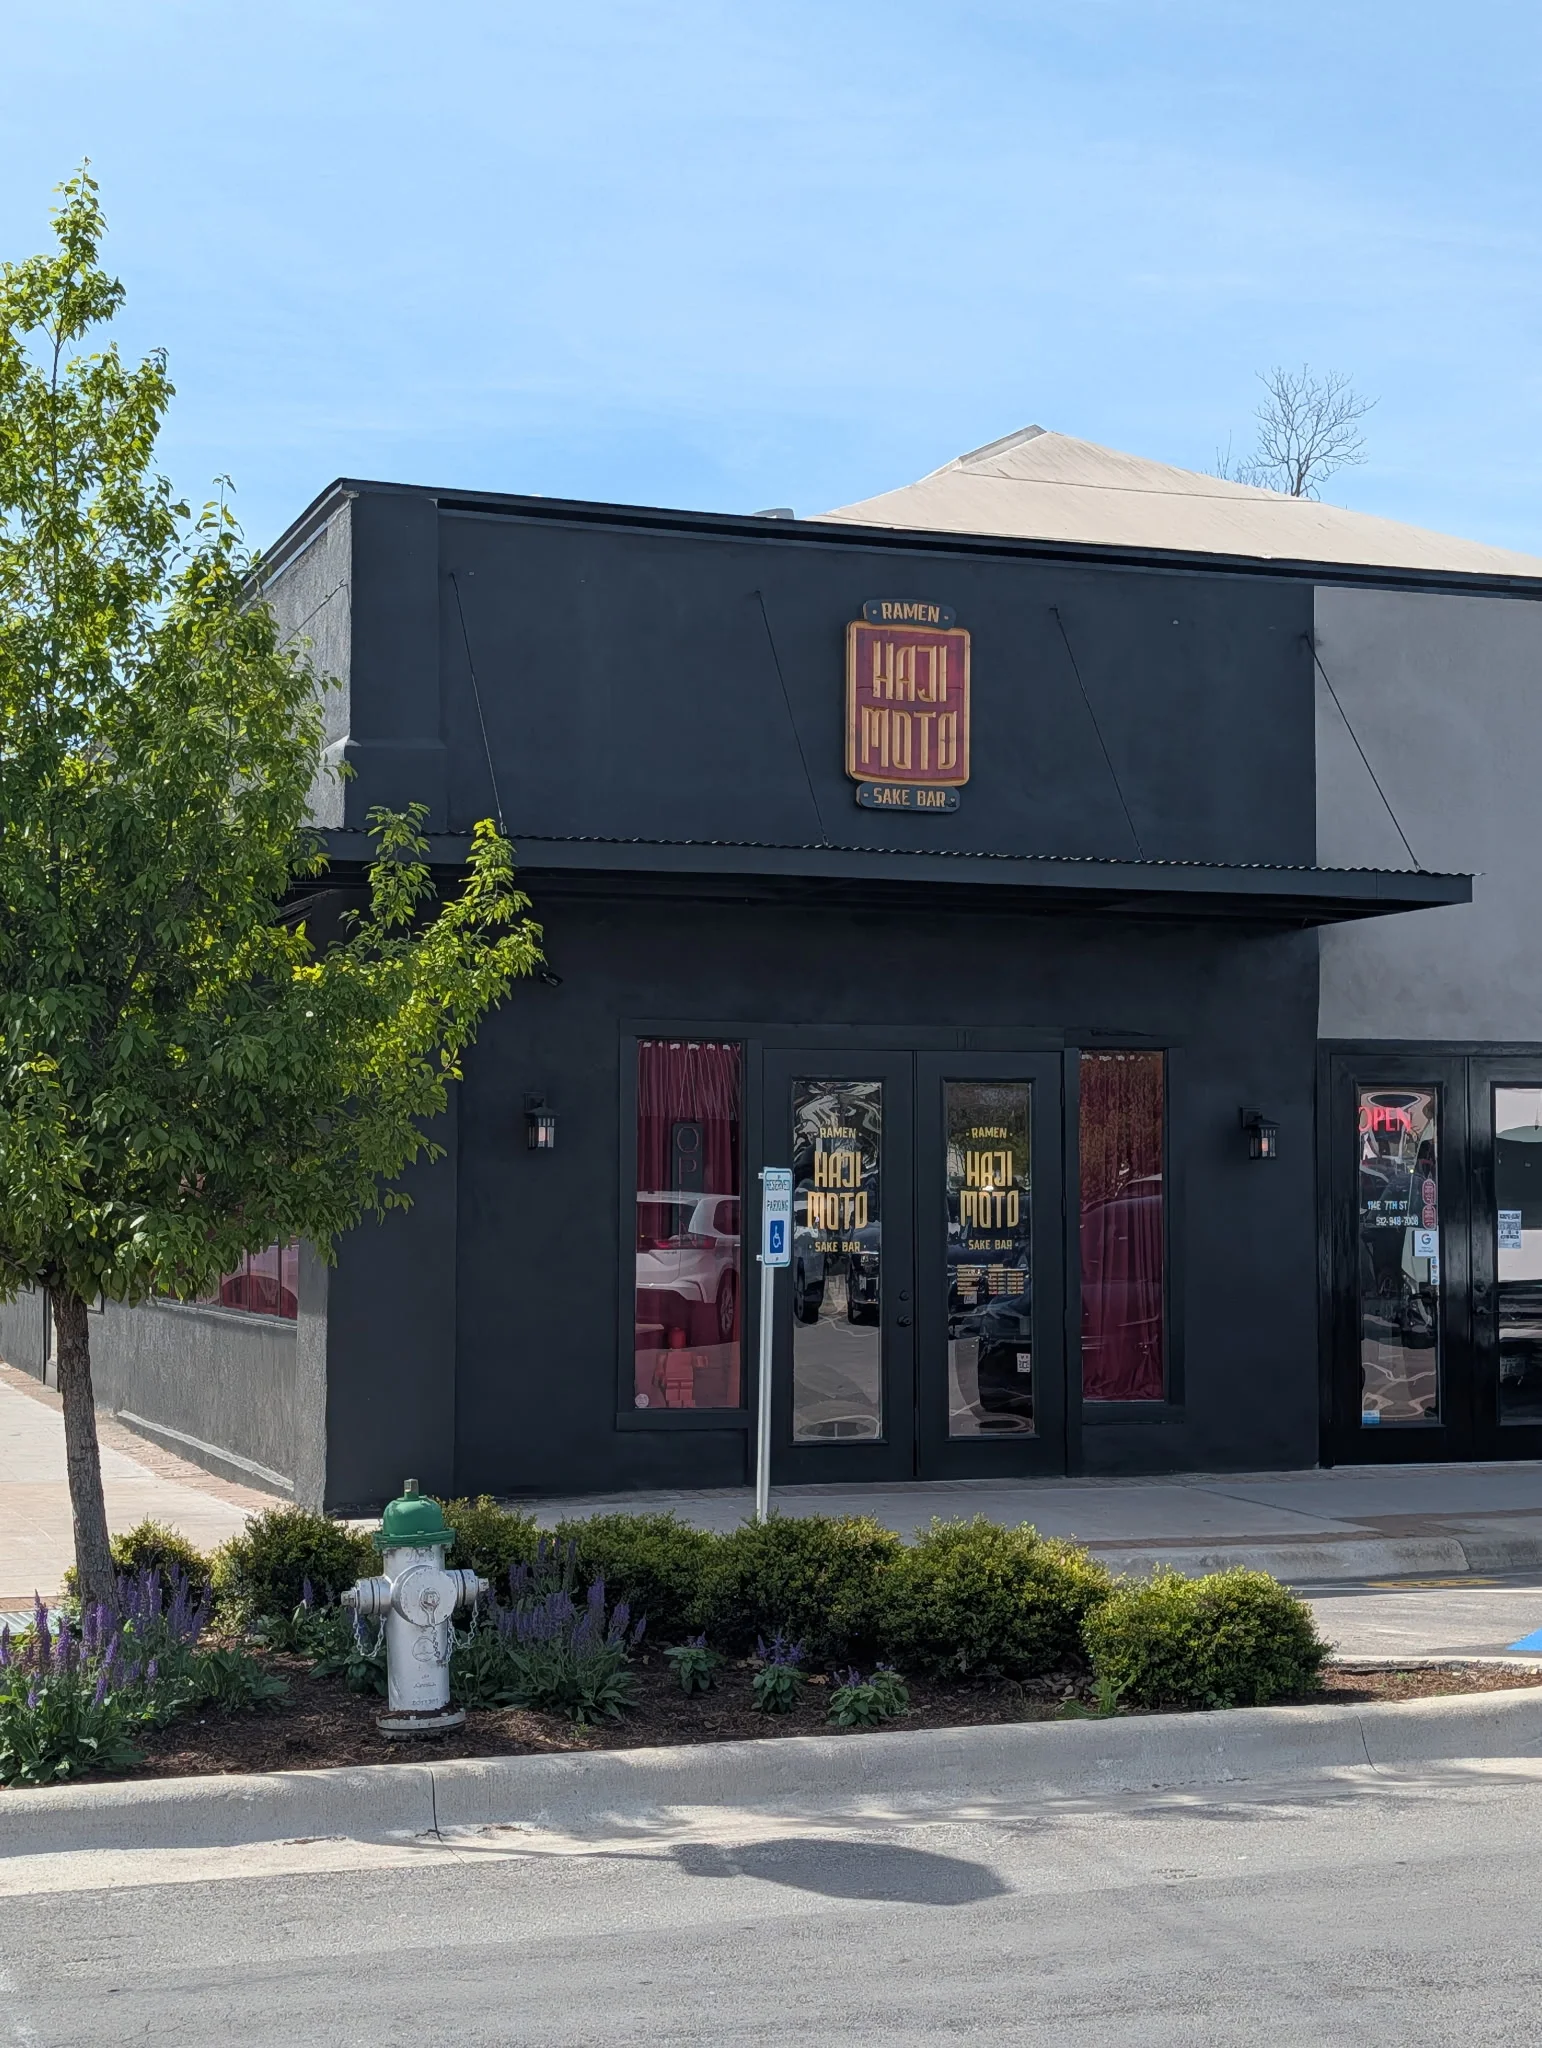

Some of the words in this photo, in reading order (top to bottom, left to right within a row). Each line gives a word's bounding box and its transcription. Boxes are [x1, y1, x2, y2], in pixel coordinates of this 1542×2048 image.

[881, 602, 940, 623] RAMEN
[872, 640, 948, 702] HAJI
[861, 705, 958, 770] MOTO
[873, 787, 910, 805] SAKE
[916, 790, 946, 808] BAR
[1358, 1106, 1412, 1133] OPEN
[820, 1127, 857, 1139] RAMEN
[971, 1127, 1007, 1139] RAMEN
[814, 1151, 862, 1188] HAJI
[966, 1150, 1013, 1187] HAJI
[807, 1191, 868, 1230] MOTO
[960, 1190, 1020, 1228] MOTO
[1398, 1200, 1408, 1211] ST
[815, 1241, 838, 1252] SAKE
[842, 1241, 861, 1252] BAR
[968, 1239, 991, 1250] SAKE
[994, 1239, 1013, 1250] BAR
